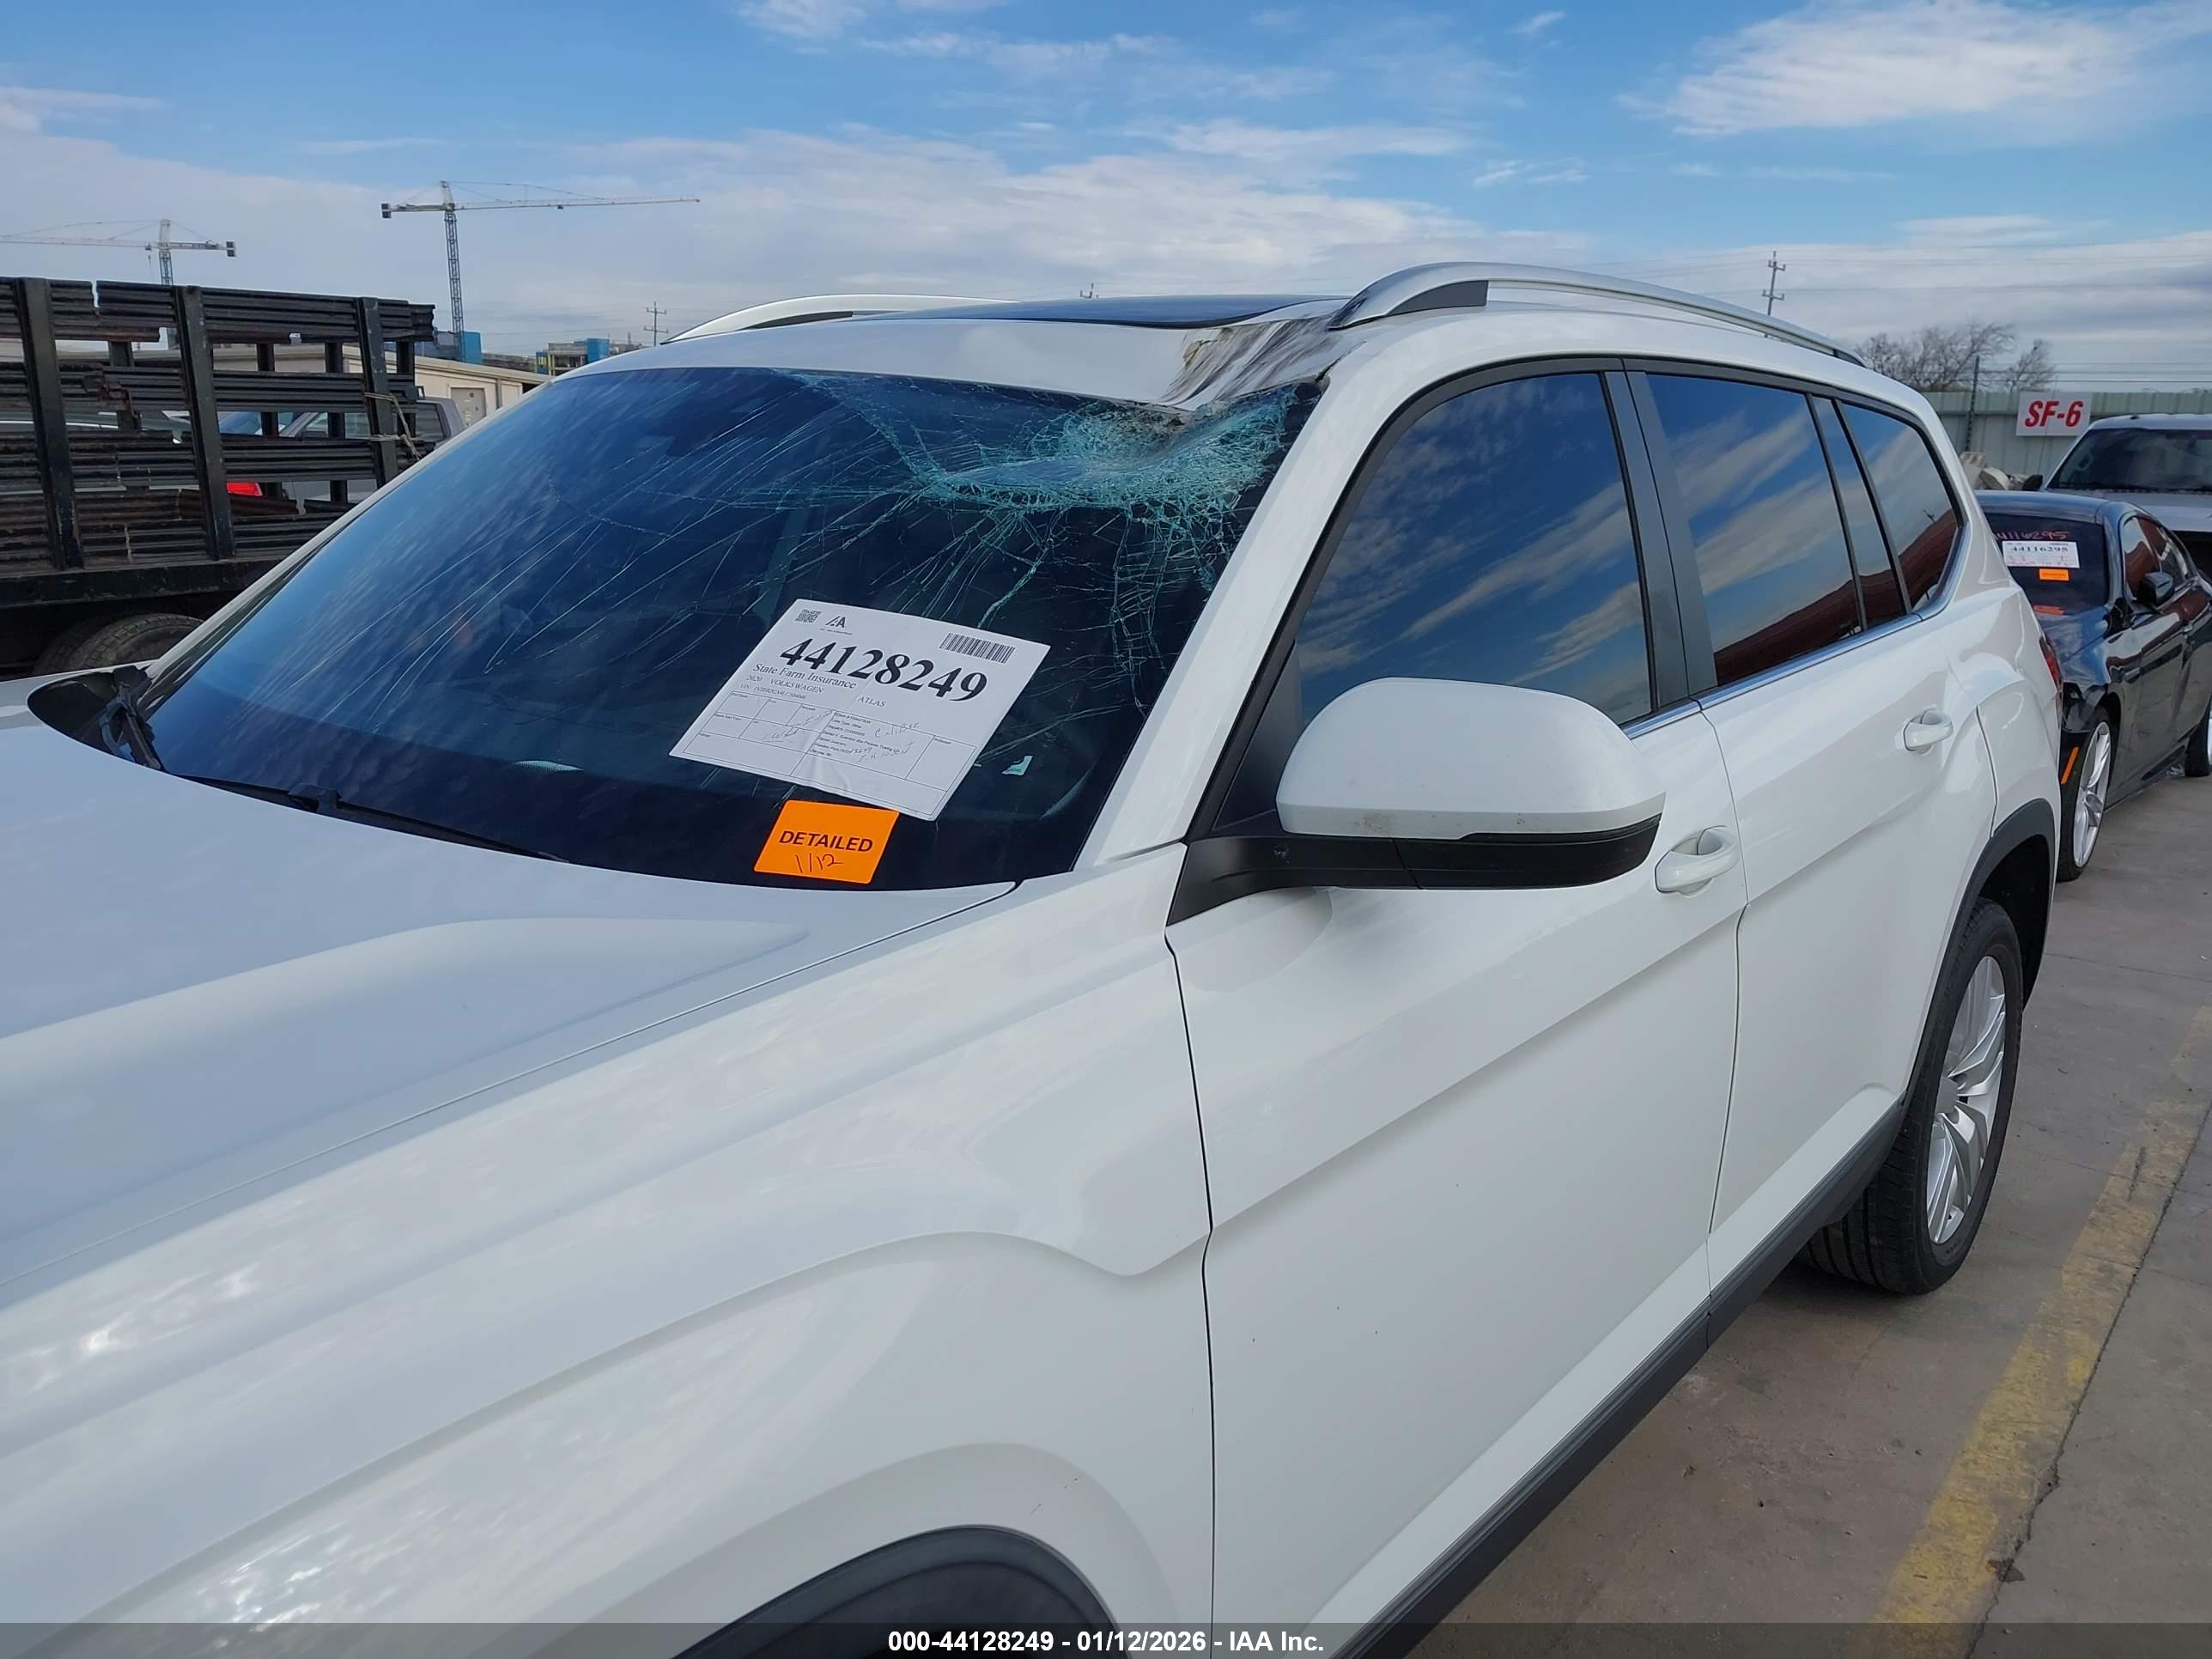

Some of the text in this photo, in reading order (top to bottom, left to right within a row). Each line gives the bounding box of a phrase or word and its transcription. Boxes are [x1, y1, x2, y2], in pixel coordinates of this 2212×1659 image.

[2025, 400, 2083, 427] SF-6
[752, 663, 857, 689] State Farm Insurance
[780, 638, 988, 701] 44128249
[770, 678, 824, 693] VOLKSWAGEN
[858, 696, 886, 708] ATLAS
[779, 830, 873, 852] DETAILED
